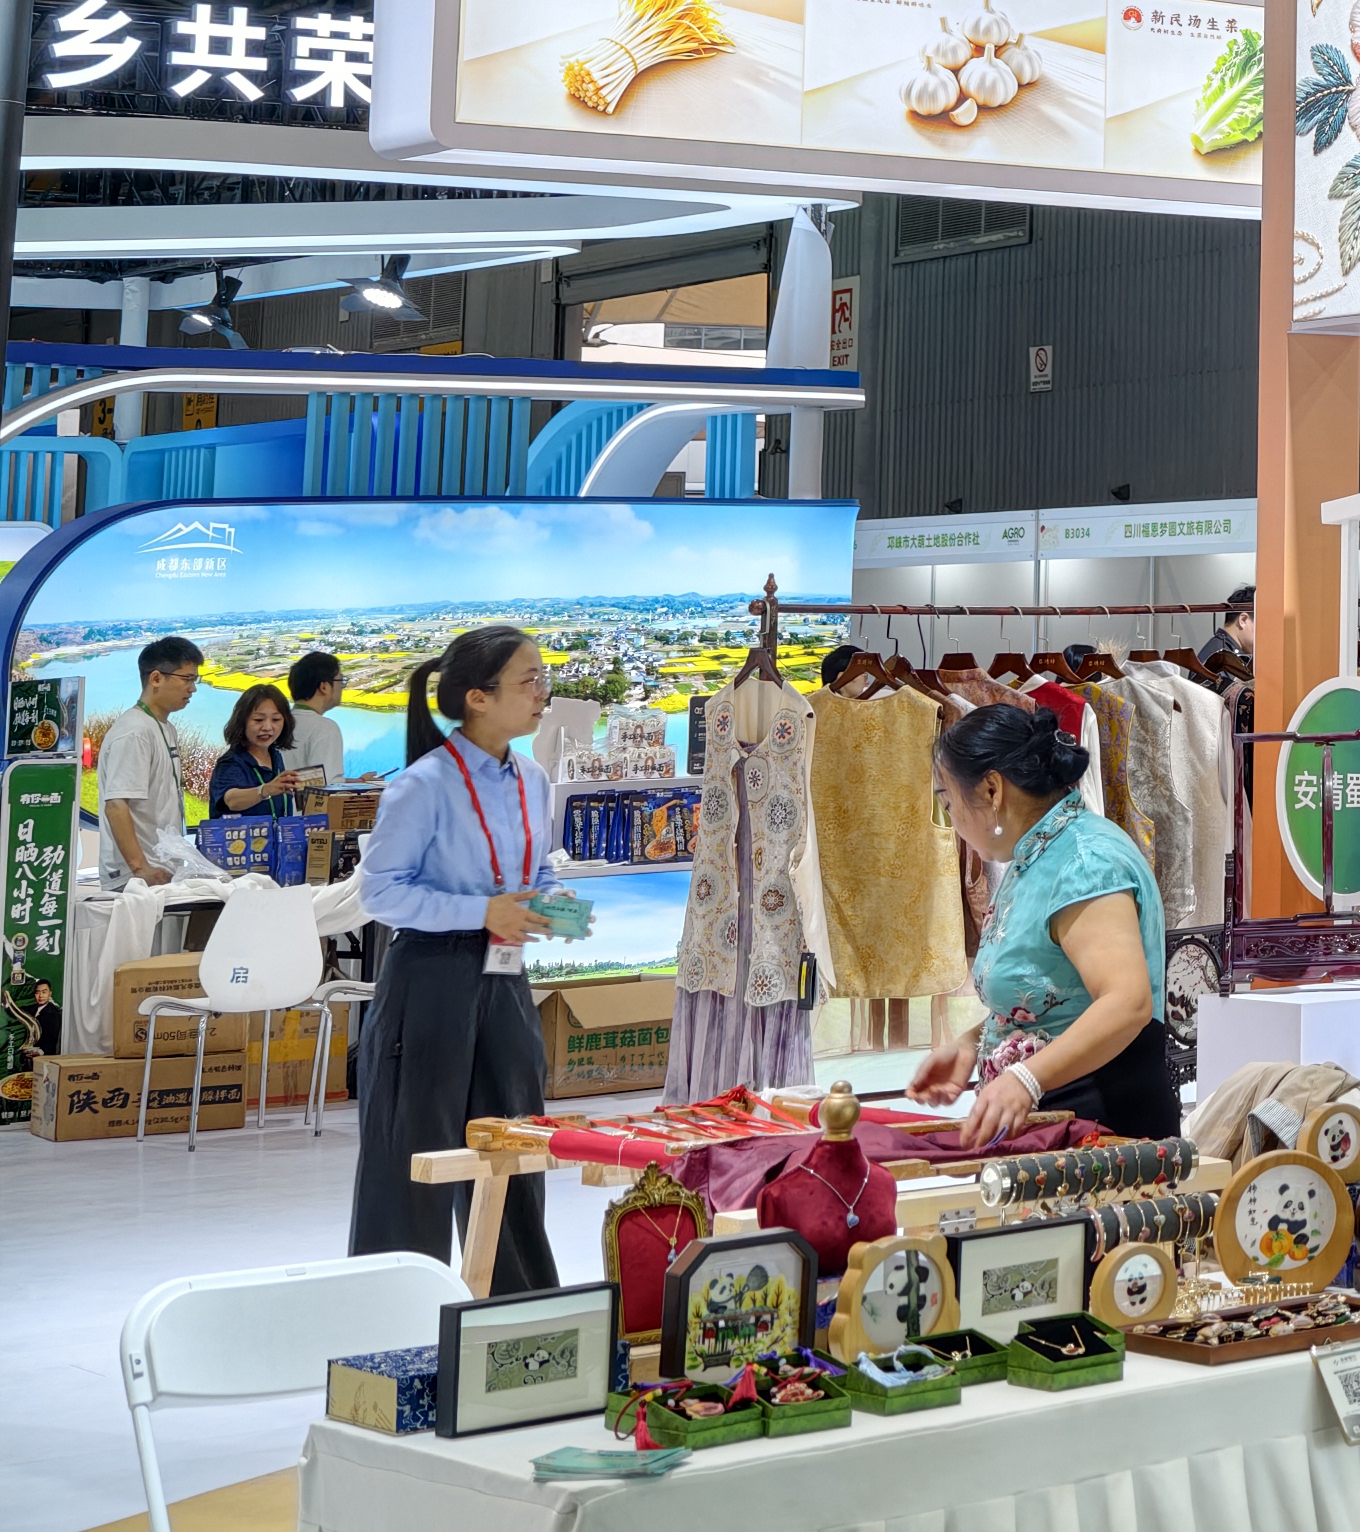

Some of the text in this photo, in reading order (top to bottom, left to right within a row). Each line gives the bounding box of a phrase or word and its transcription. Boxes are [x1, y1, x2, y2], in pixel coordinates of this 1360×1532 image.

[1151, 9, 1238, 34] 新民场生菜
[832, 354, 850, 367] EXIT
[1002, 526, 1026, 540] AGRO
[1065, 526, 1091, 540] B3034
[11, 819, 38, 926] 日晒八小时
[34, 844, 66, 956] 劲道每一刻
[567, 1025, 670, 1054] 鲜鹿茸菇菌包
[67, 1086, 131, 1116] 陕西
